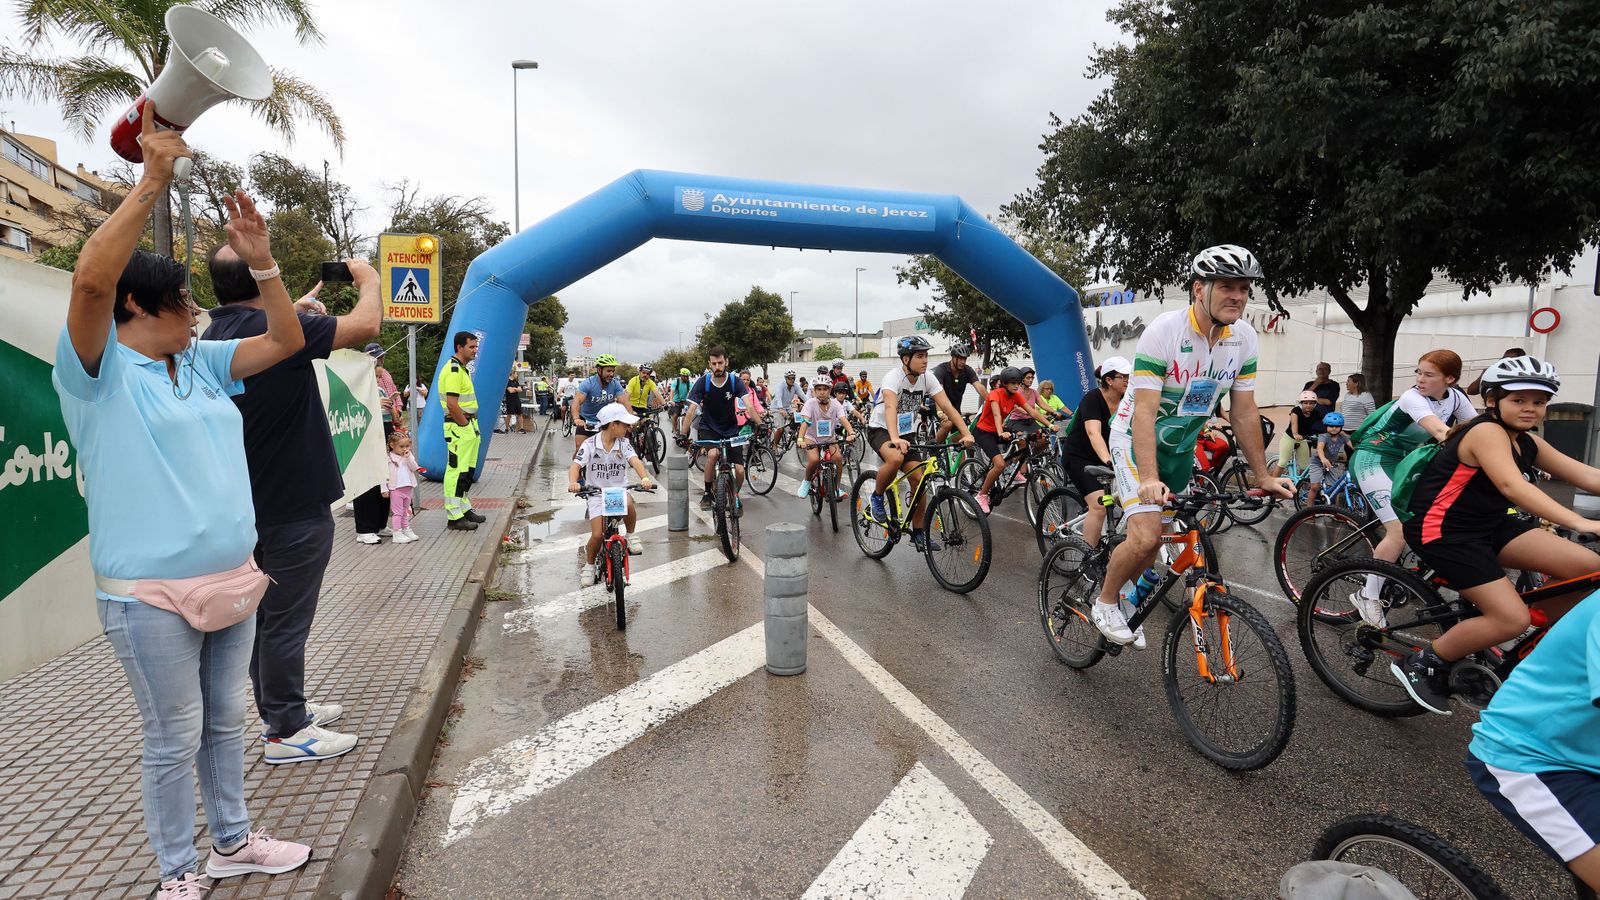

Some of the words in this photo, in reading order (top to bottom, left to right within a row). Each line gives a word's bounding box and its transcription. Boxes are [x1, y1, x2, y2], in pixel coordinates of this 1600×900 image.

[712, 193, 851, 213] Ayuntamiento
[855, 205, 878, 214] de
[881, 206, 928, 218] Jerez
[712, 204, 777, 217] Deportes
[388, 306, 434, 318] PEATONES
[591, 462, 626, 472] Emirates
[597, 471, 605, 479] FLY
